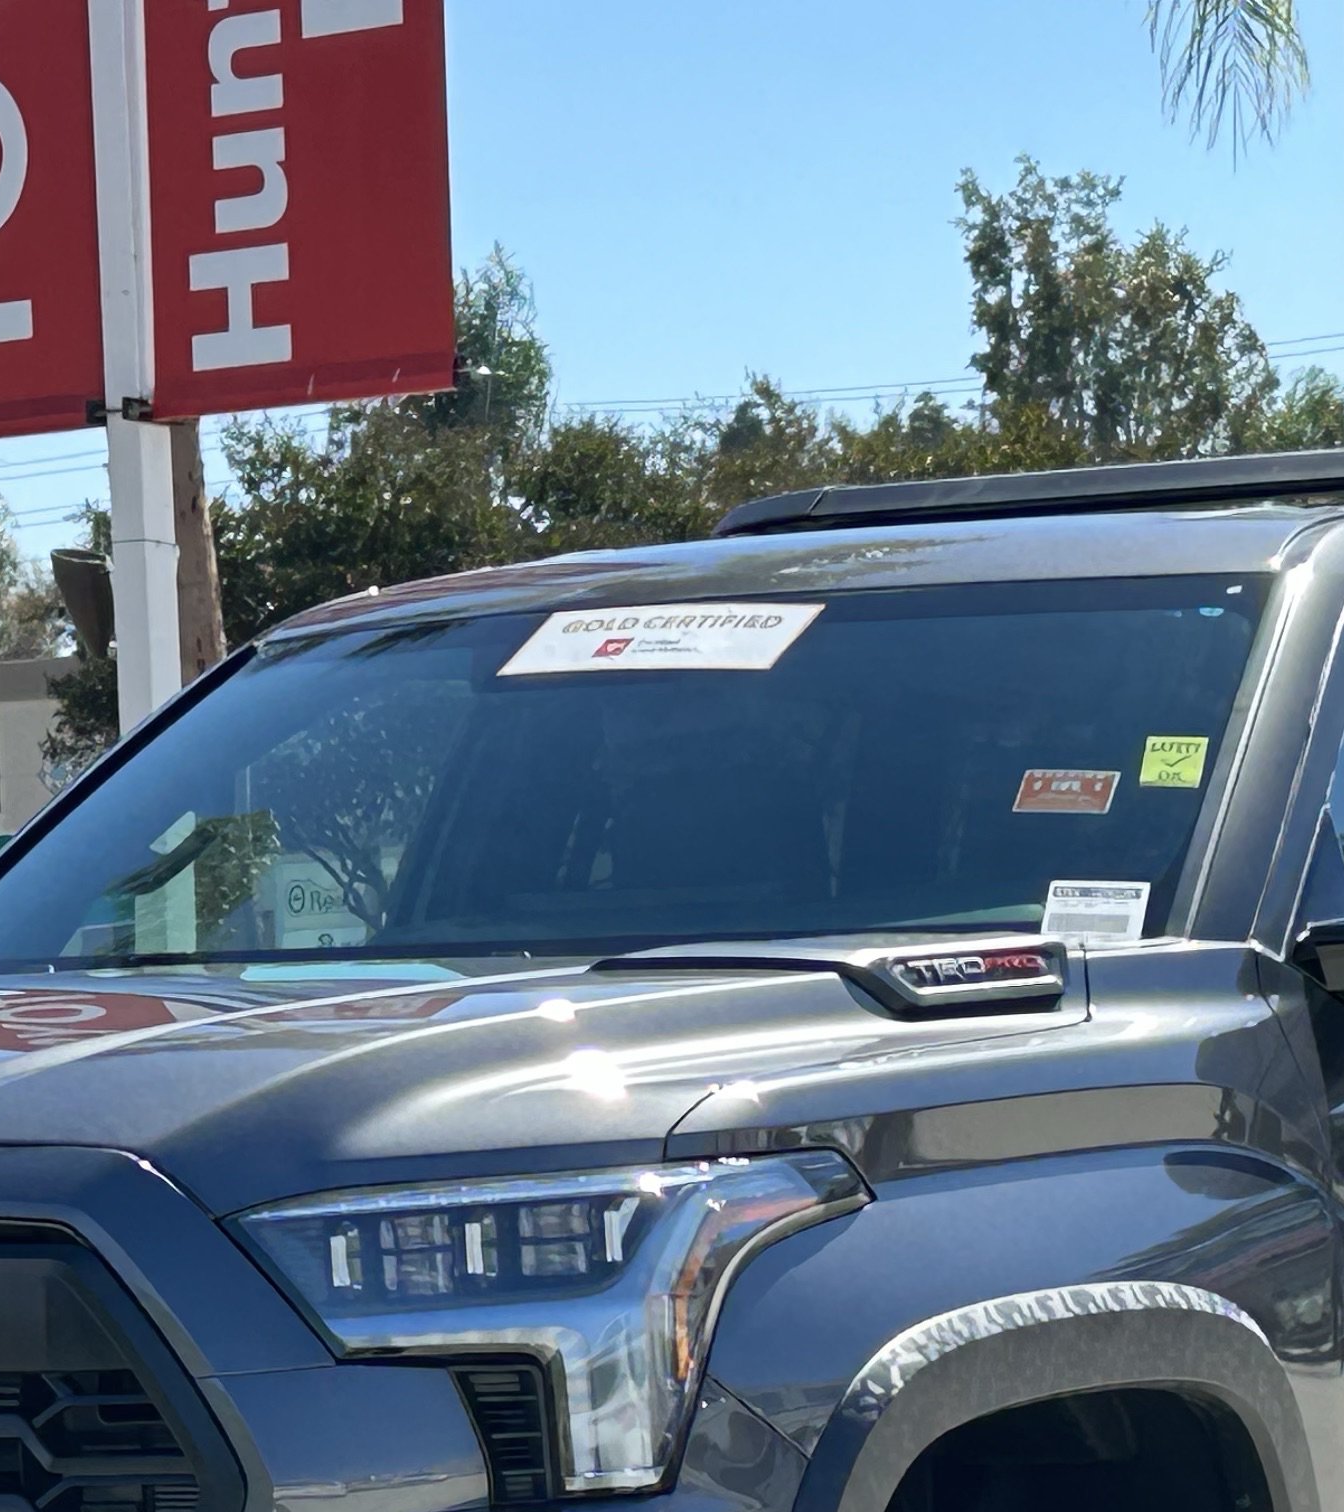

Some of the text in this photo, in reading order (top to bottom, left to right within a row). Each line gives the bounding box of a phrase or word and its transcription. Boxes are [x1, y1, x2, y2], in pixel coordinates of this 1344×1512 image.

[189, 0, 293, 372] Hun
[562, 614, 785, 634] GOLD CERTIFIED
[906, 956, 986, 984] TRD
